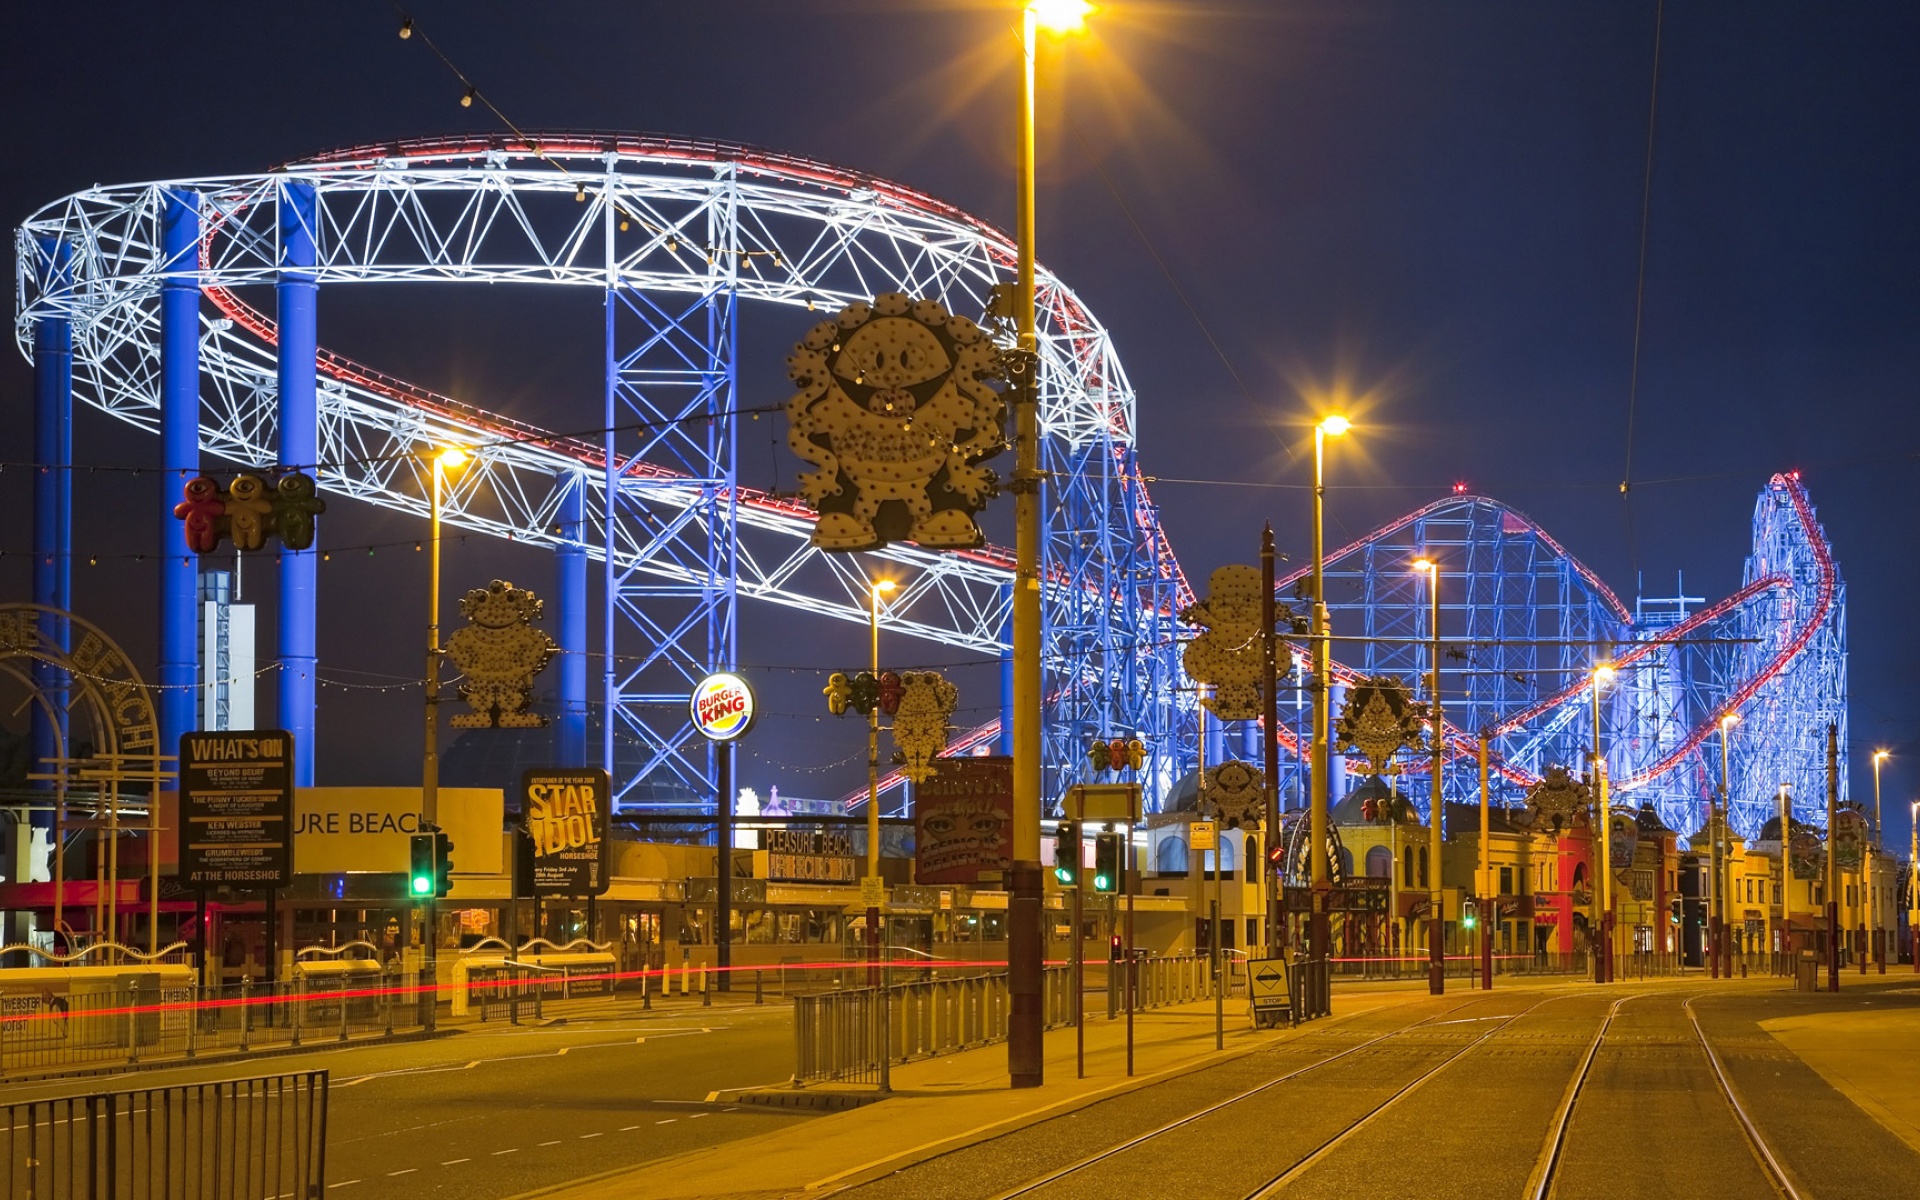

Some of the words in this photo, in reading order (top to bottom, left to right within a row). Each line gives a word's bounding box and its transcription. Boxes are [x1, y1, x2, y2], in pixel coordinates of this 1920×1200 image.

[72, 631, 154, 750] BEACH
[699, 687, 742, 711] BURGER
[702, 696, 745, 727] KING
[191, 738, 258, 760] WHAT'S
[262, 738, 283, 758] ON
[207, 769, 241, 777] BEYOND
[242, 768, 265, 776] BELIEF
[528, 784, 597, 820] STAR
[207, 821, 225, 830] KEN
[226, 820, 262, 829] WEBSTER
[533, 814, 601, 858] IDOL
[205, 848, 264, 857] GRUMBLEWEEDS
[766, 829, 815, 853] PLEASURE
[822, 833, 852, 856] BEACH
[560, 852, 598, 860] HORSESHOE
[191, 871, 204, 881] AT
[204, 871, 222, 880] THE
[224, 870, 280, 880] HORSESHOE
